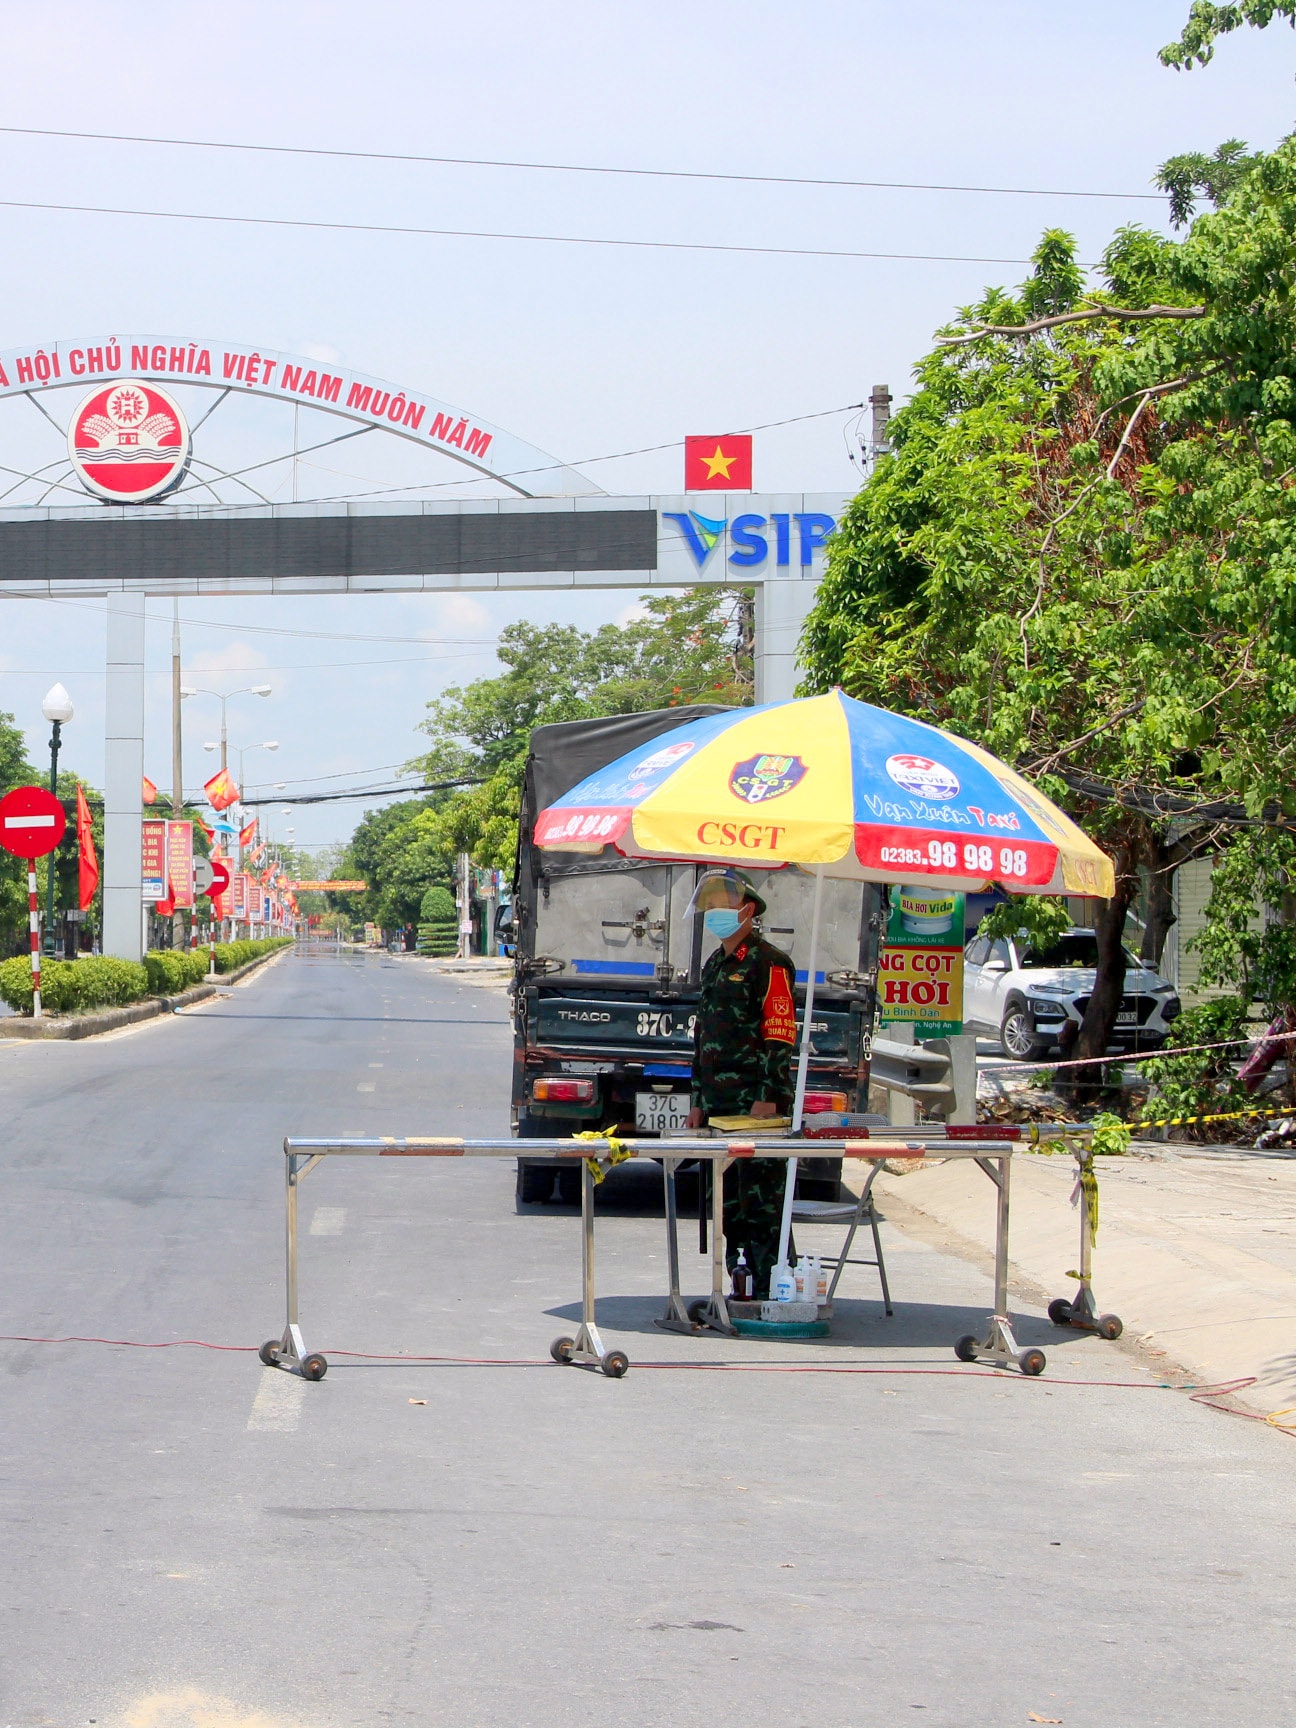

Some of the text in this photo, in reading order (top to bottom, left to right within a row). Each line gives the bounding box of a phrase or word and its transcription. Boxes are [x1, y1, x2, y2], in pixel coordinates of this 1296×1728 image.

[16, 349, 61, 386] HỘI
[69, 336, 122, 376] CHỦ
[131, 343, 212, 376] NGHĨA
[222, 352, 277, 388] VIỆT
[281, 364, 344, 403] NAM
[346, 383, 425, 430] MUÔN
[428, 412, 494, 459] NĂM
[662, 509, 837, 567] VSIP
[737, 777, 793, 787] CSGT
[967, 806, 1021, 831] Taxi
[697, 821, 786, 850] CSGT
[964, 844, 993, 871] 98
[1000, 848, 1027, 877] 98
[902, 899, 914, 912] BIA
[929, 901, 953, 914] Vida
[911, 954, 956, 977] CỌT
[884, 979, 950, 1005] HƠI
[558, 1010, 611, 1022] THACO
[636, 1011, 673, 1037] 37C
[943, 1021, 952, 1029] An
[649, 1095, 678, 1112] 37C
